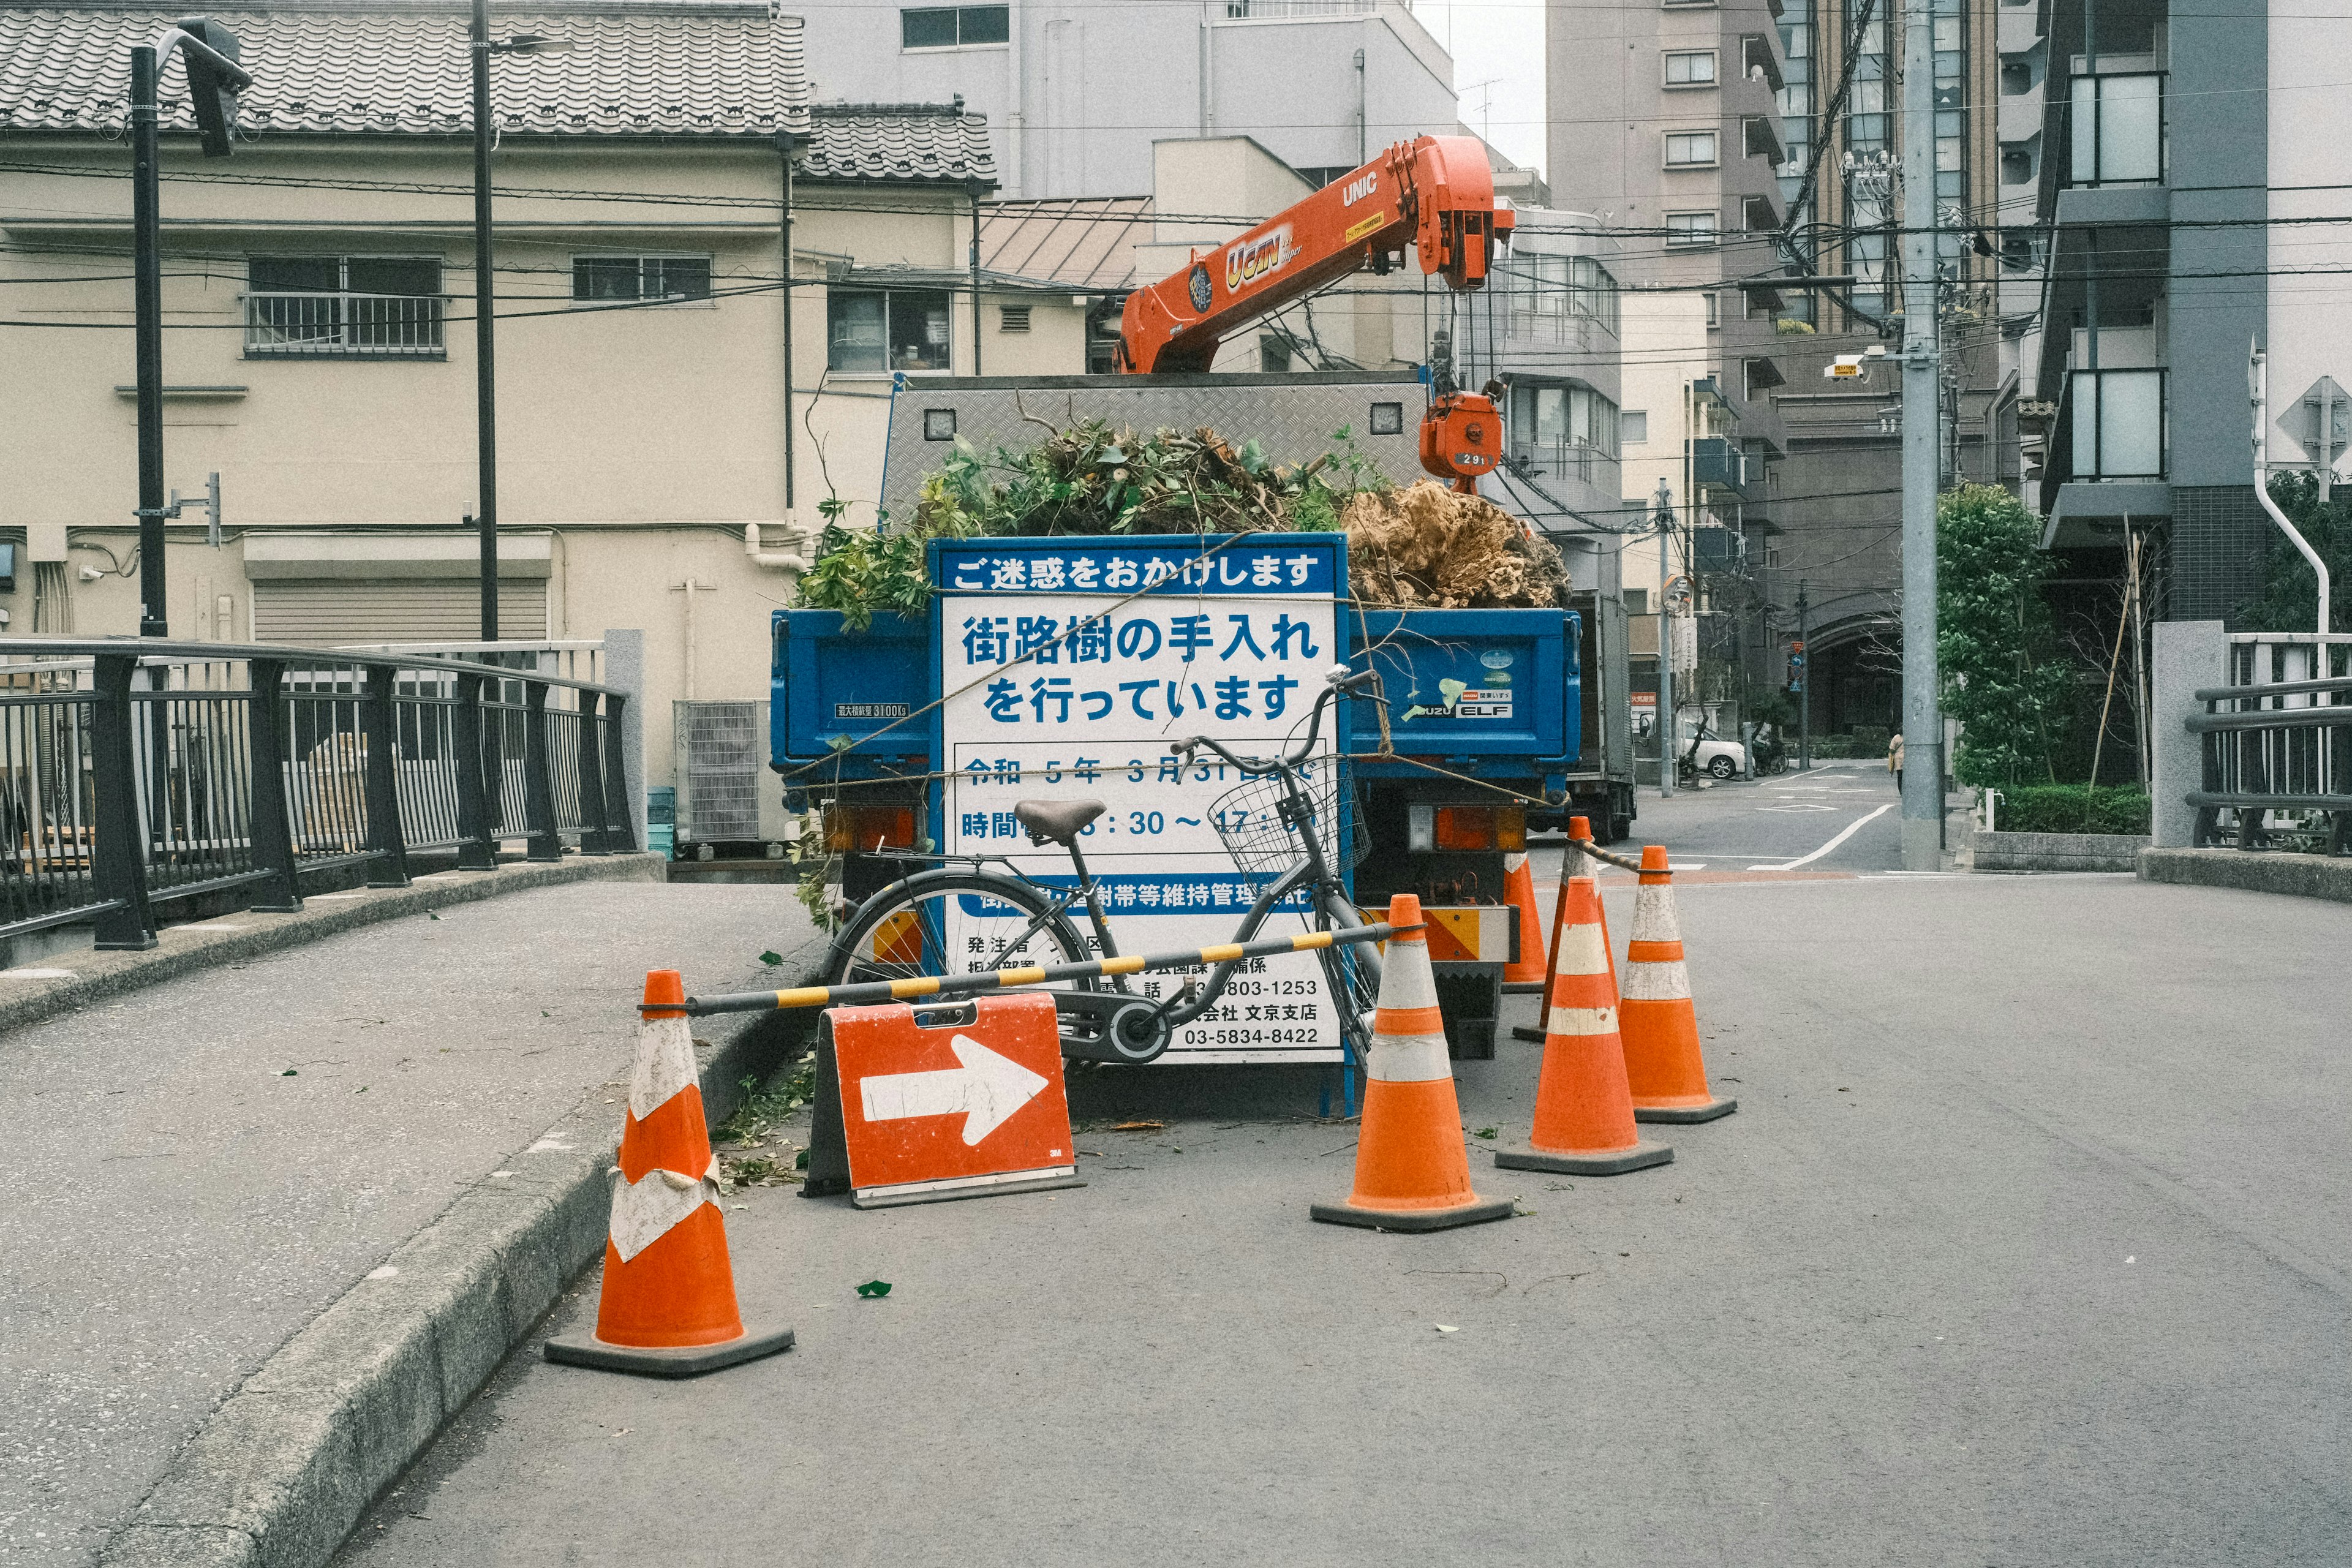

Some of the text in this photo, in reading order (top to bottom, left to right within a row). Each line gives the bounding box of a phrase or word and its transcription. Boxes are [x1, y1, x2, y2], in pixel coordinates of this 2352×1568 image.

[1343, 172, 1378, 207] UNIC
[1281, 245, 1303, 265] Super
[954, 554, 1318, 589] ご迷惑をおかけします
[962, 614, 1319, 665] 街路樹の手入れ
[983, 674, 1298, 723] を行っています
[839, 705, 906, 717] 最大積載量 3100Kg
[1415, 706, 1508, 715] UZU ELF
[965, 758, 1020, 786] 令和
[1245, 1003, 1317, 1022] 文京支店
[1185, 1028, 1318, 1044] 03-5834-8422
[1049, 1148, 1062, 1158] 3M
